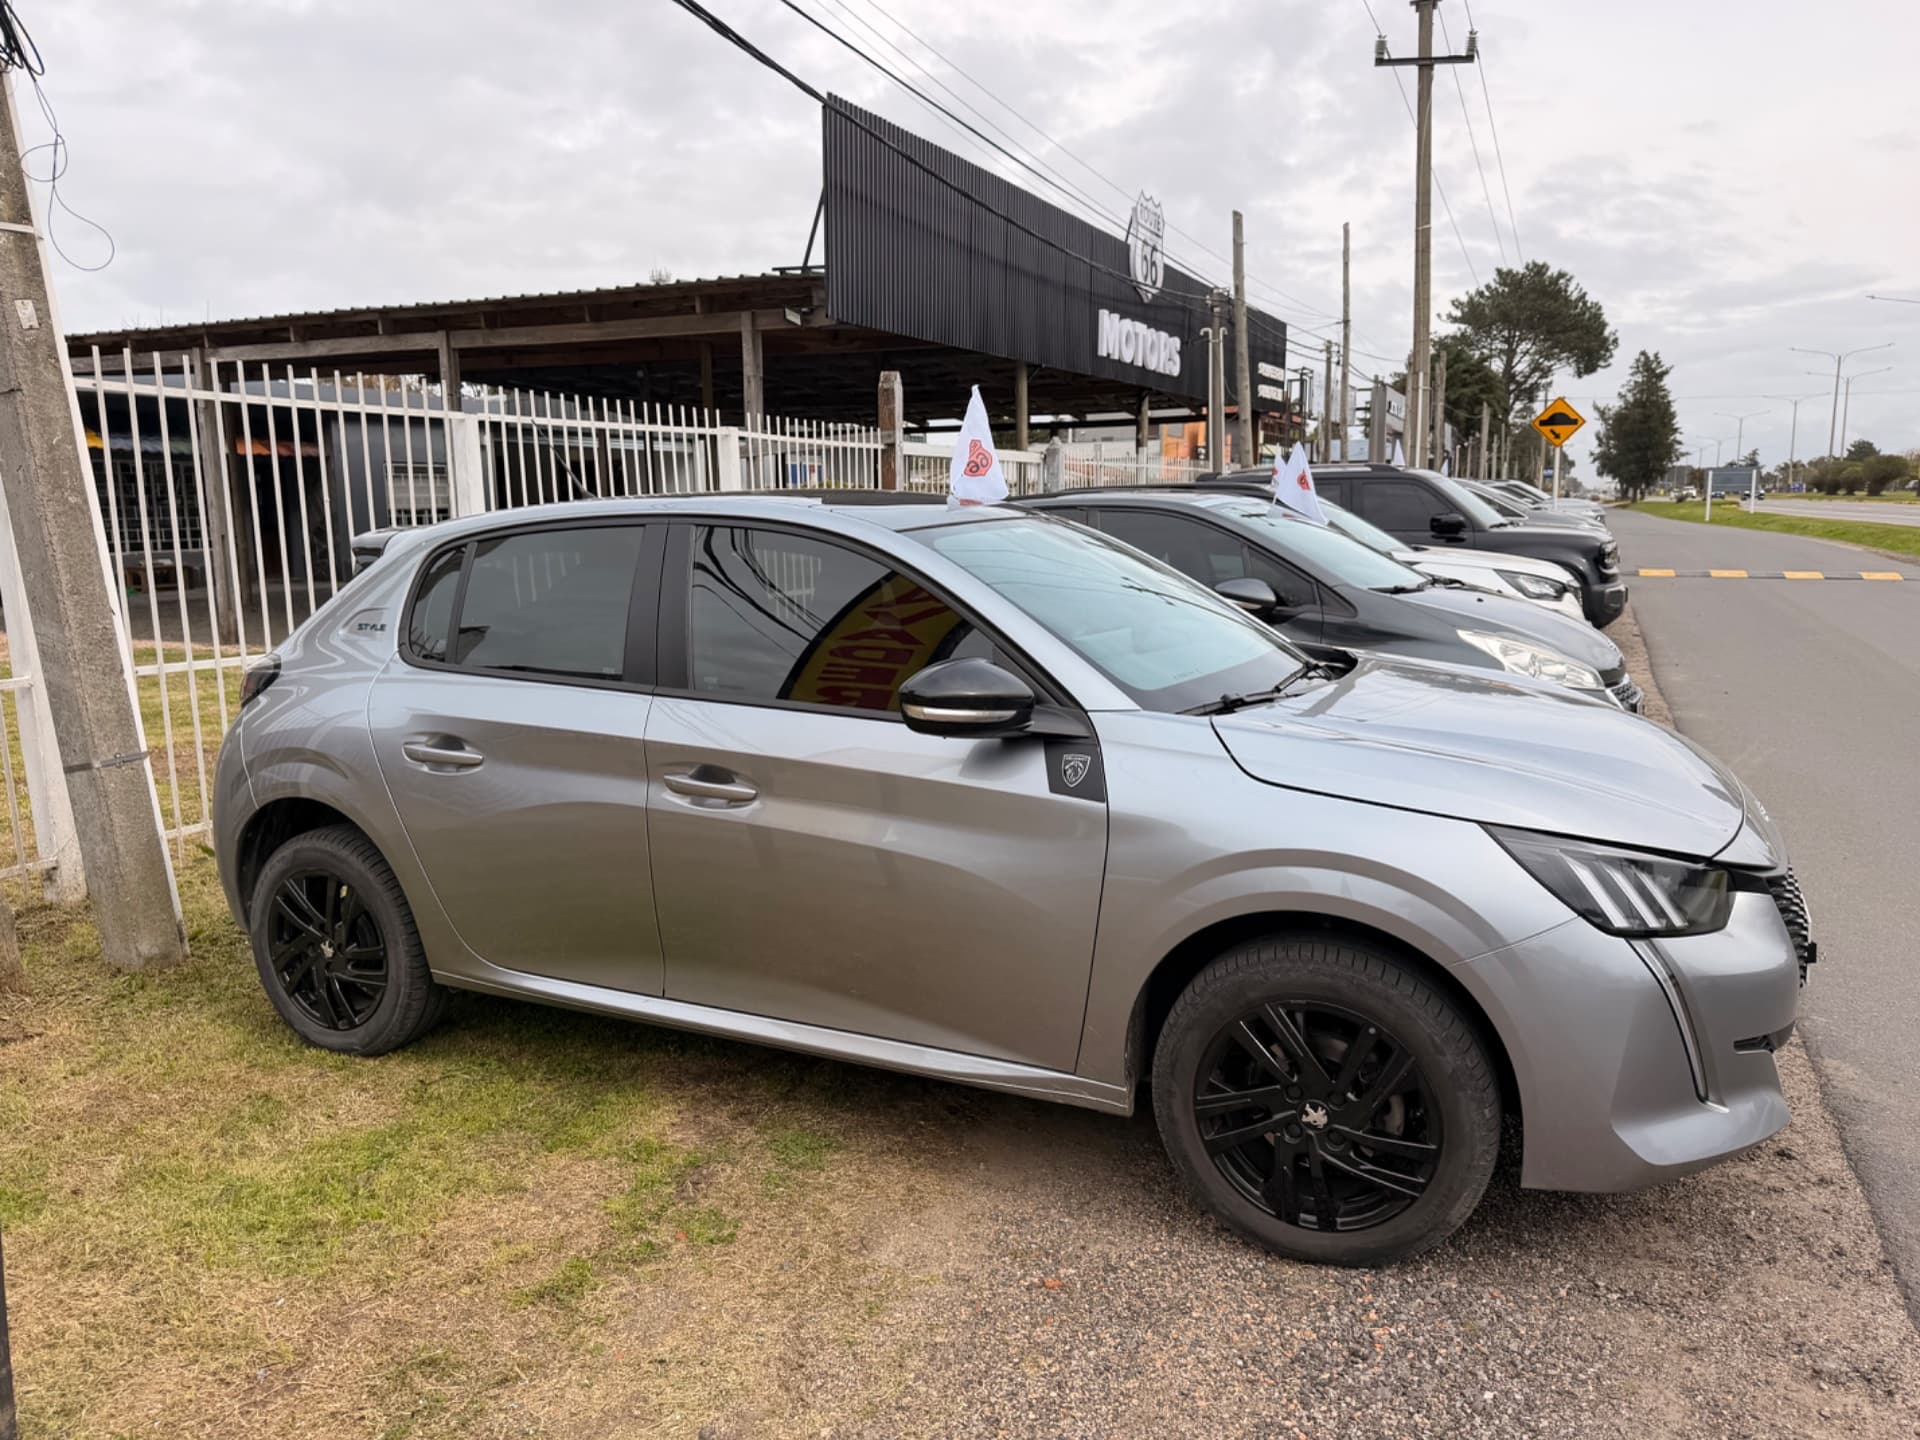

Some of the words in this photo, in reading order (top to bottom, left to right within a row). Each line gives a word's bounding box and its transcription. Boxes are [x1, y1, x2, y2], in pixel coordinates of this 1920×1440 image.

[1139, 203, 1162, 232] ROUTE
[1141, 240, 1158, 286] 66
[1097, 309, 1182, 377] MOTORS
[357, 623, 387, 631] STYLE
